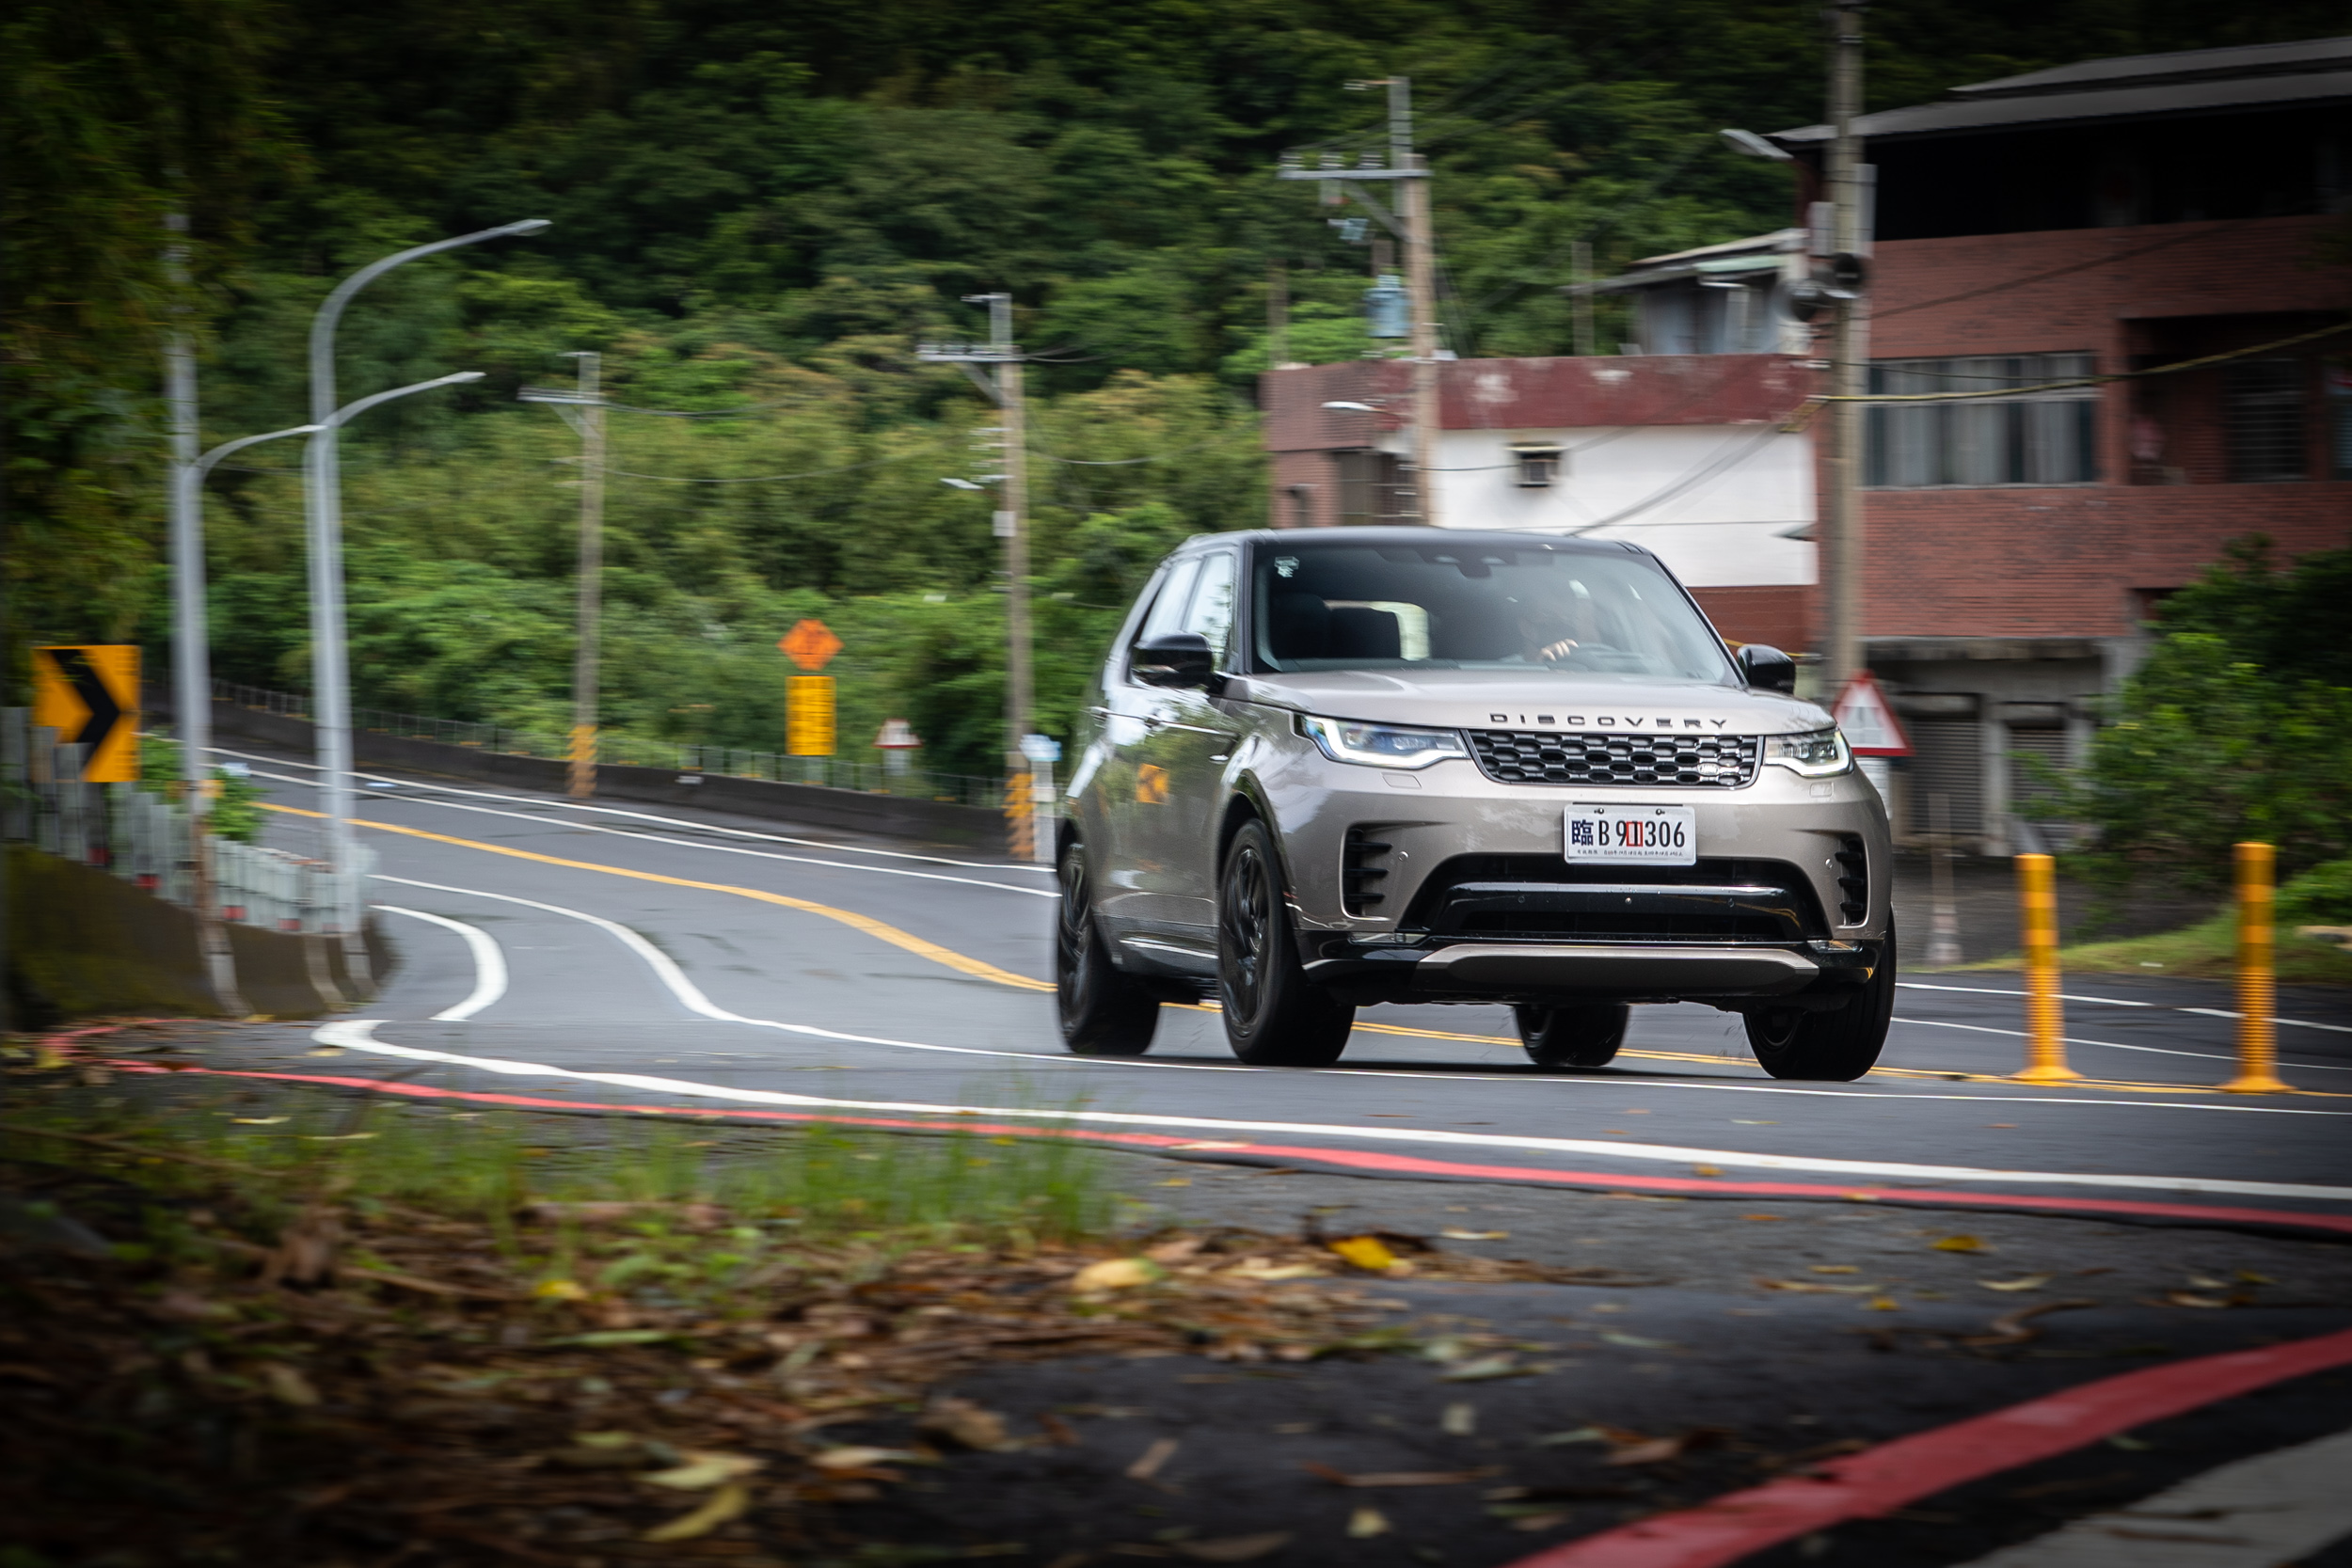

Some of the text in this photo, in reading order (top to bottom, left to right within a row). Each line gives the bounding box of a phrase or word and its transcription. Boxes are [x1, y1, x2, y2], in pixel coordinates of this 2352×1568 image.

[1489, 713, 1727, 729] DISCOVERY
[1571, 819, 1685, 848] 臨 B 91306
